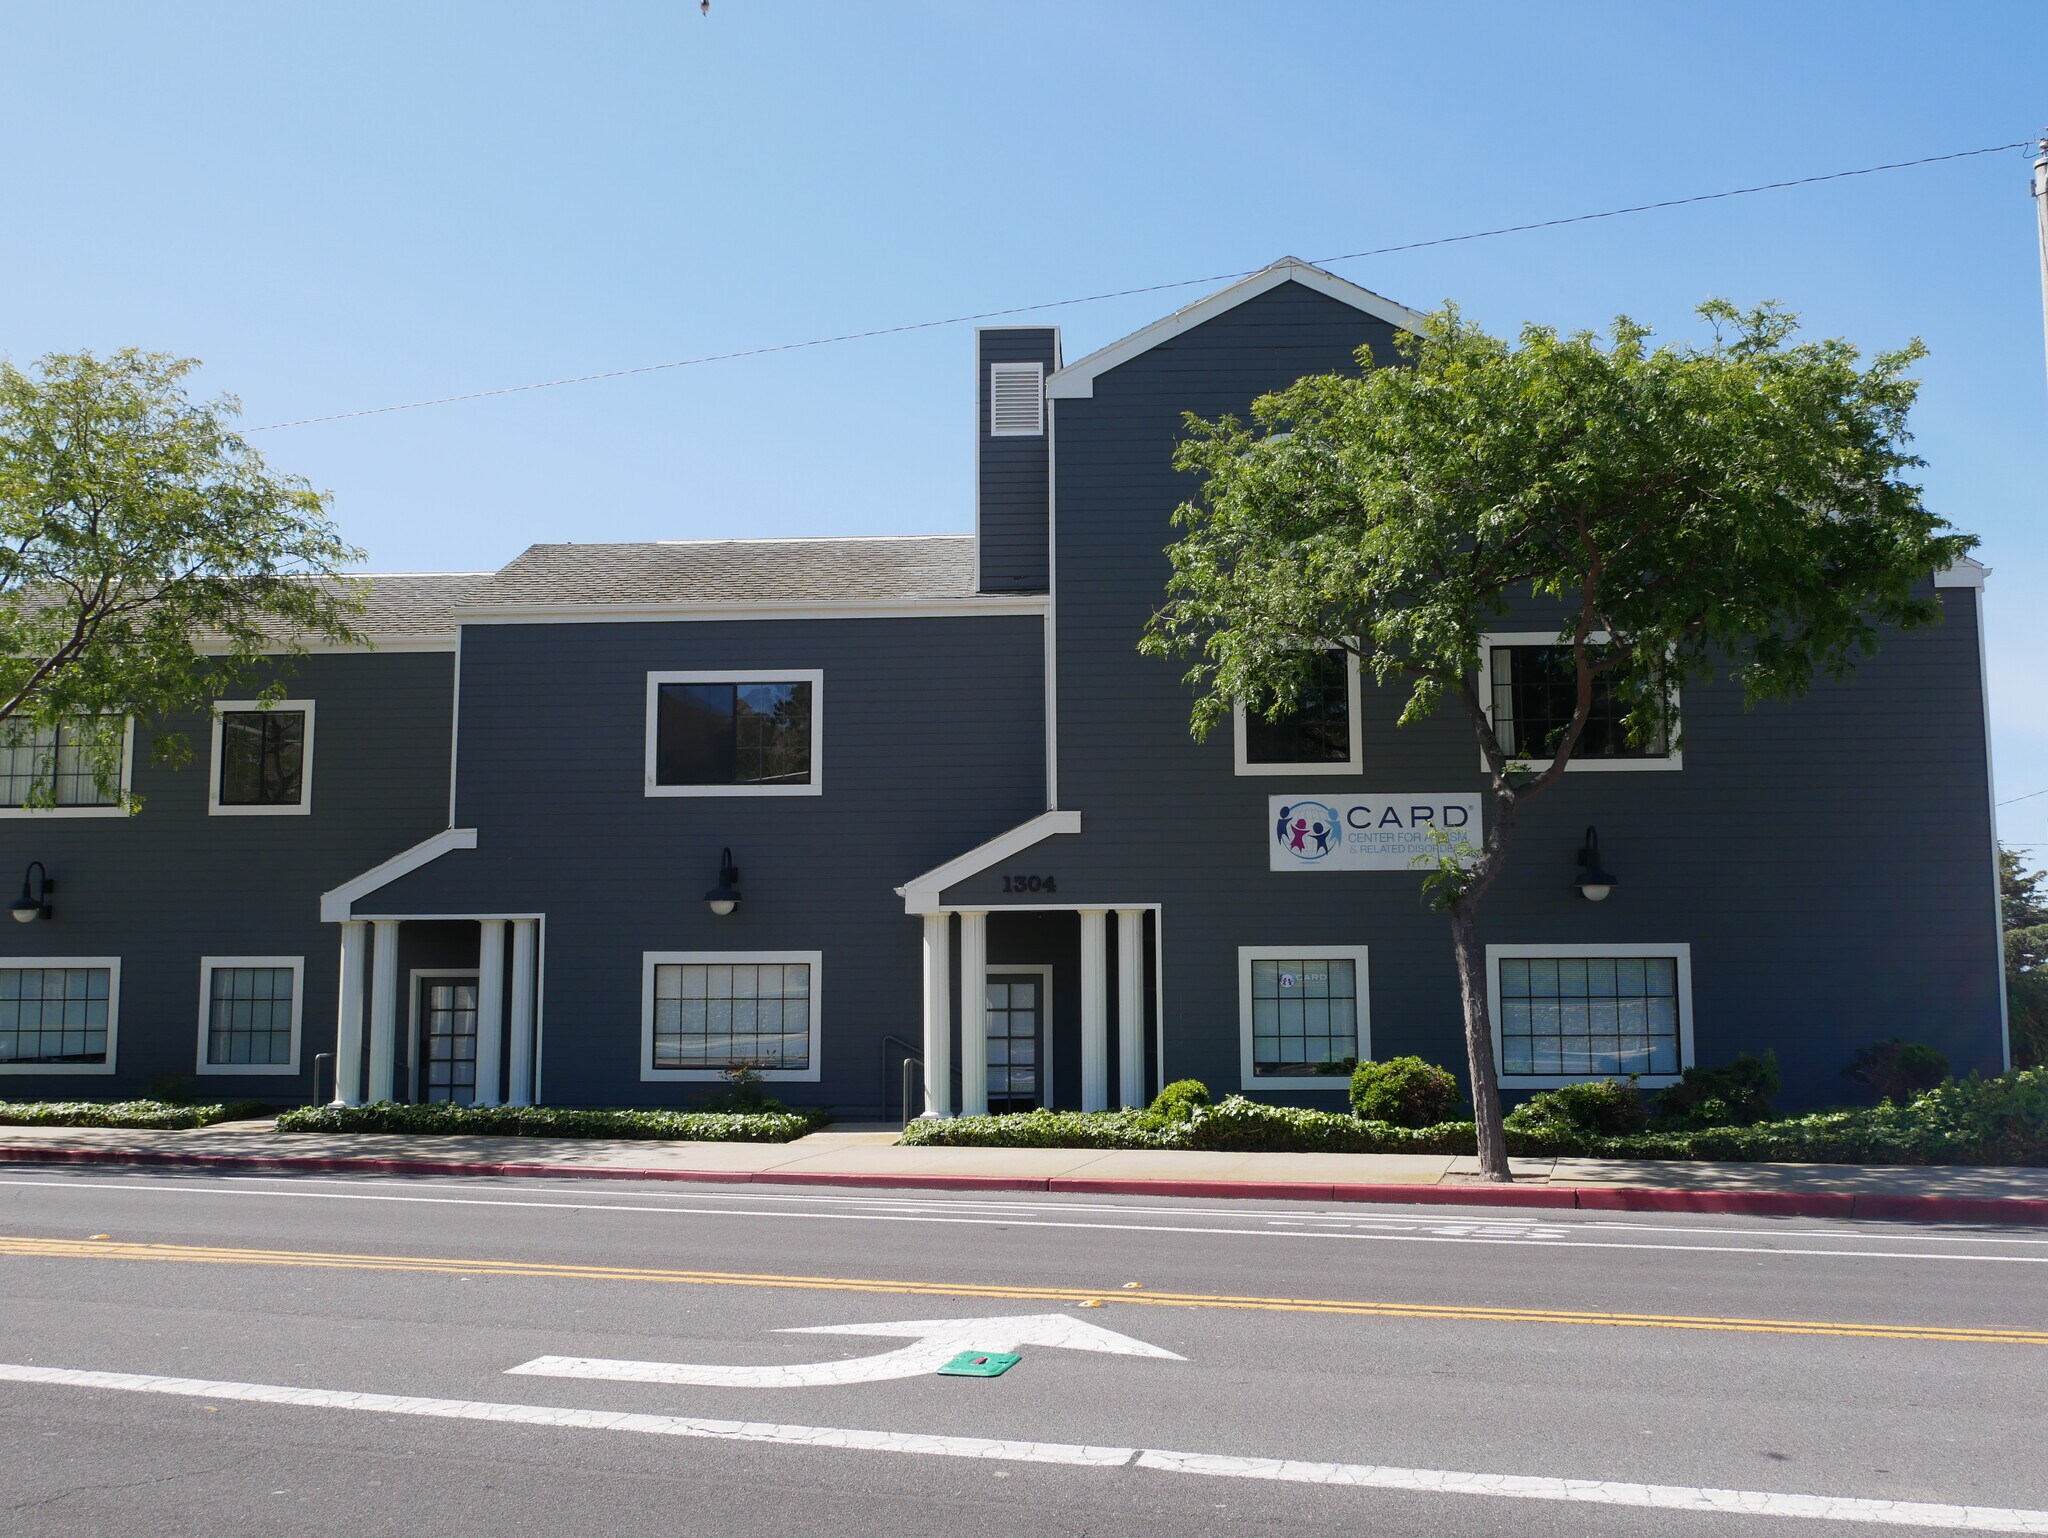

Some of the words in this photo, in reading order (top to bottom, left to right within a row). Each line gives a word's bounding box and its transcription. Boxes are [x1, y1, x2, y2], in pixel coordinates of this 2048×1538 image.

[1348, 832, 1394, 843] CENTER
[1398, 832, 1422, 842] FOR
[1424, 832, 1467, 842] AISM
[1349, 844, 1358, 854] &
[1360, 844, 1406, 853] RELATED
[1002, 875, 1056, 892] 1304
